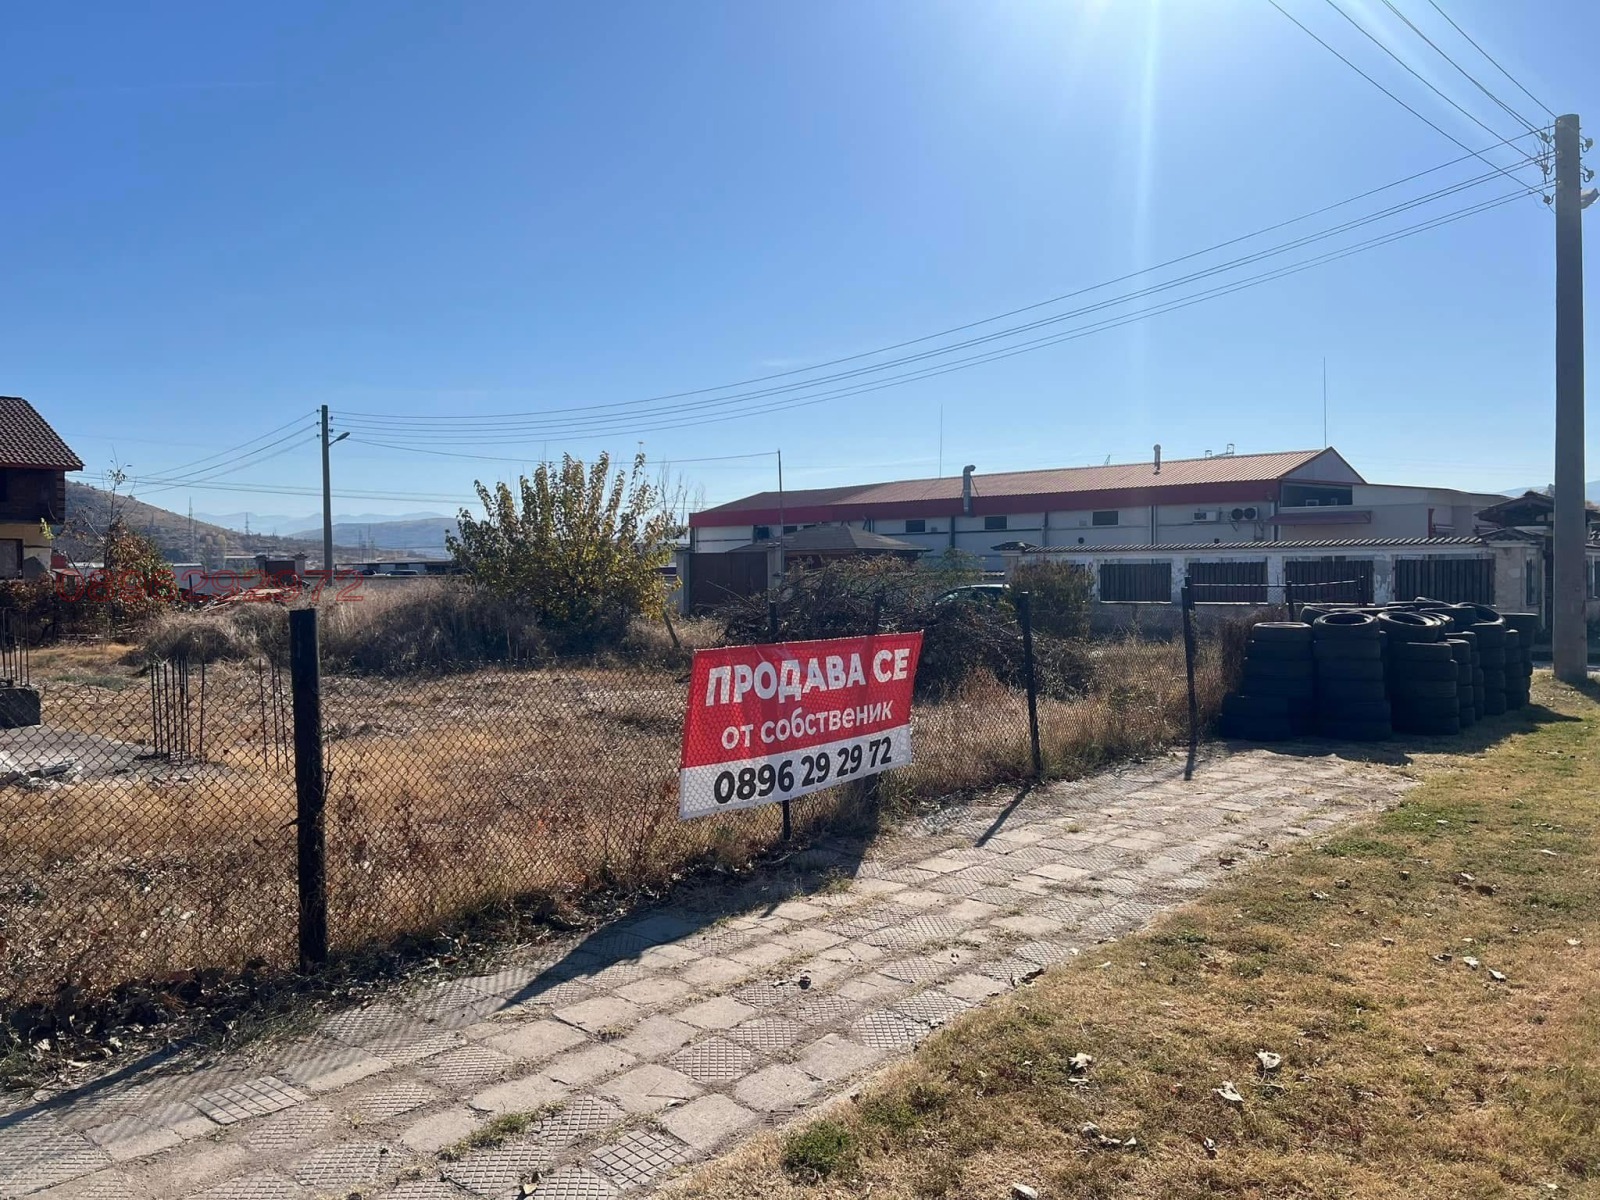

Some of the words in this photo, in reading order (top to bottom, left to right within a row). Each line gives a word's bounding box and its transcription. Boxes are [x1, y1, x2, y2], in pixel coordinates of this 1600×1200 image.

[705, 652, 866, 707] ПРОДАВА
[873, 648, 910, 683] СЕ
[760, 700, 893, 744] собственик
[713, 759, 795, 805] 0896
[801, 752, 831, 788] 29
[836, 744, 863, 778] 29
[869, 736, 892, 768] 72
